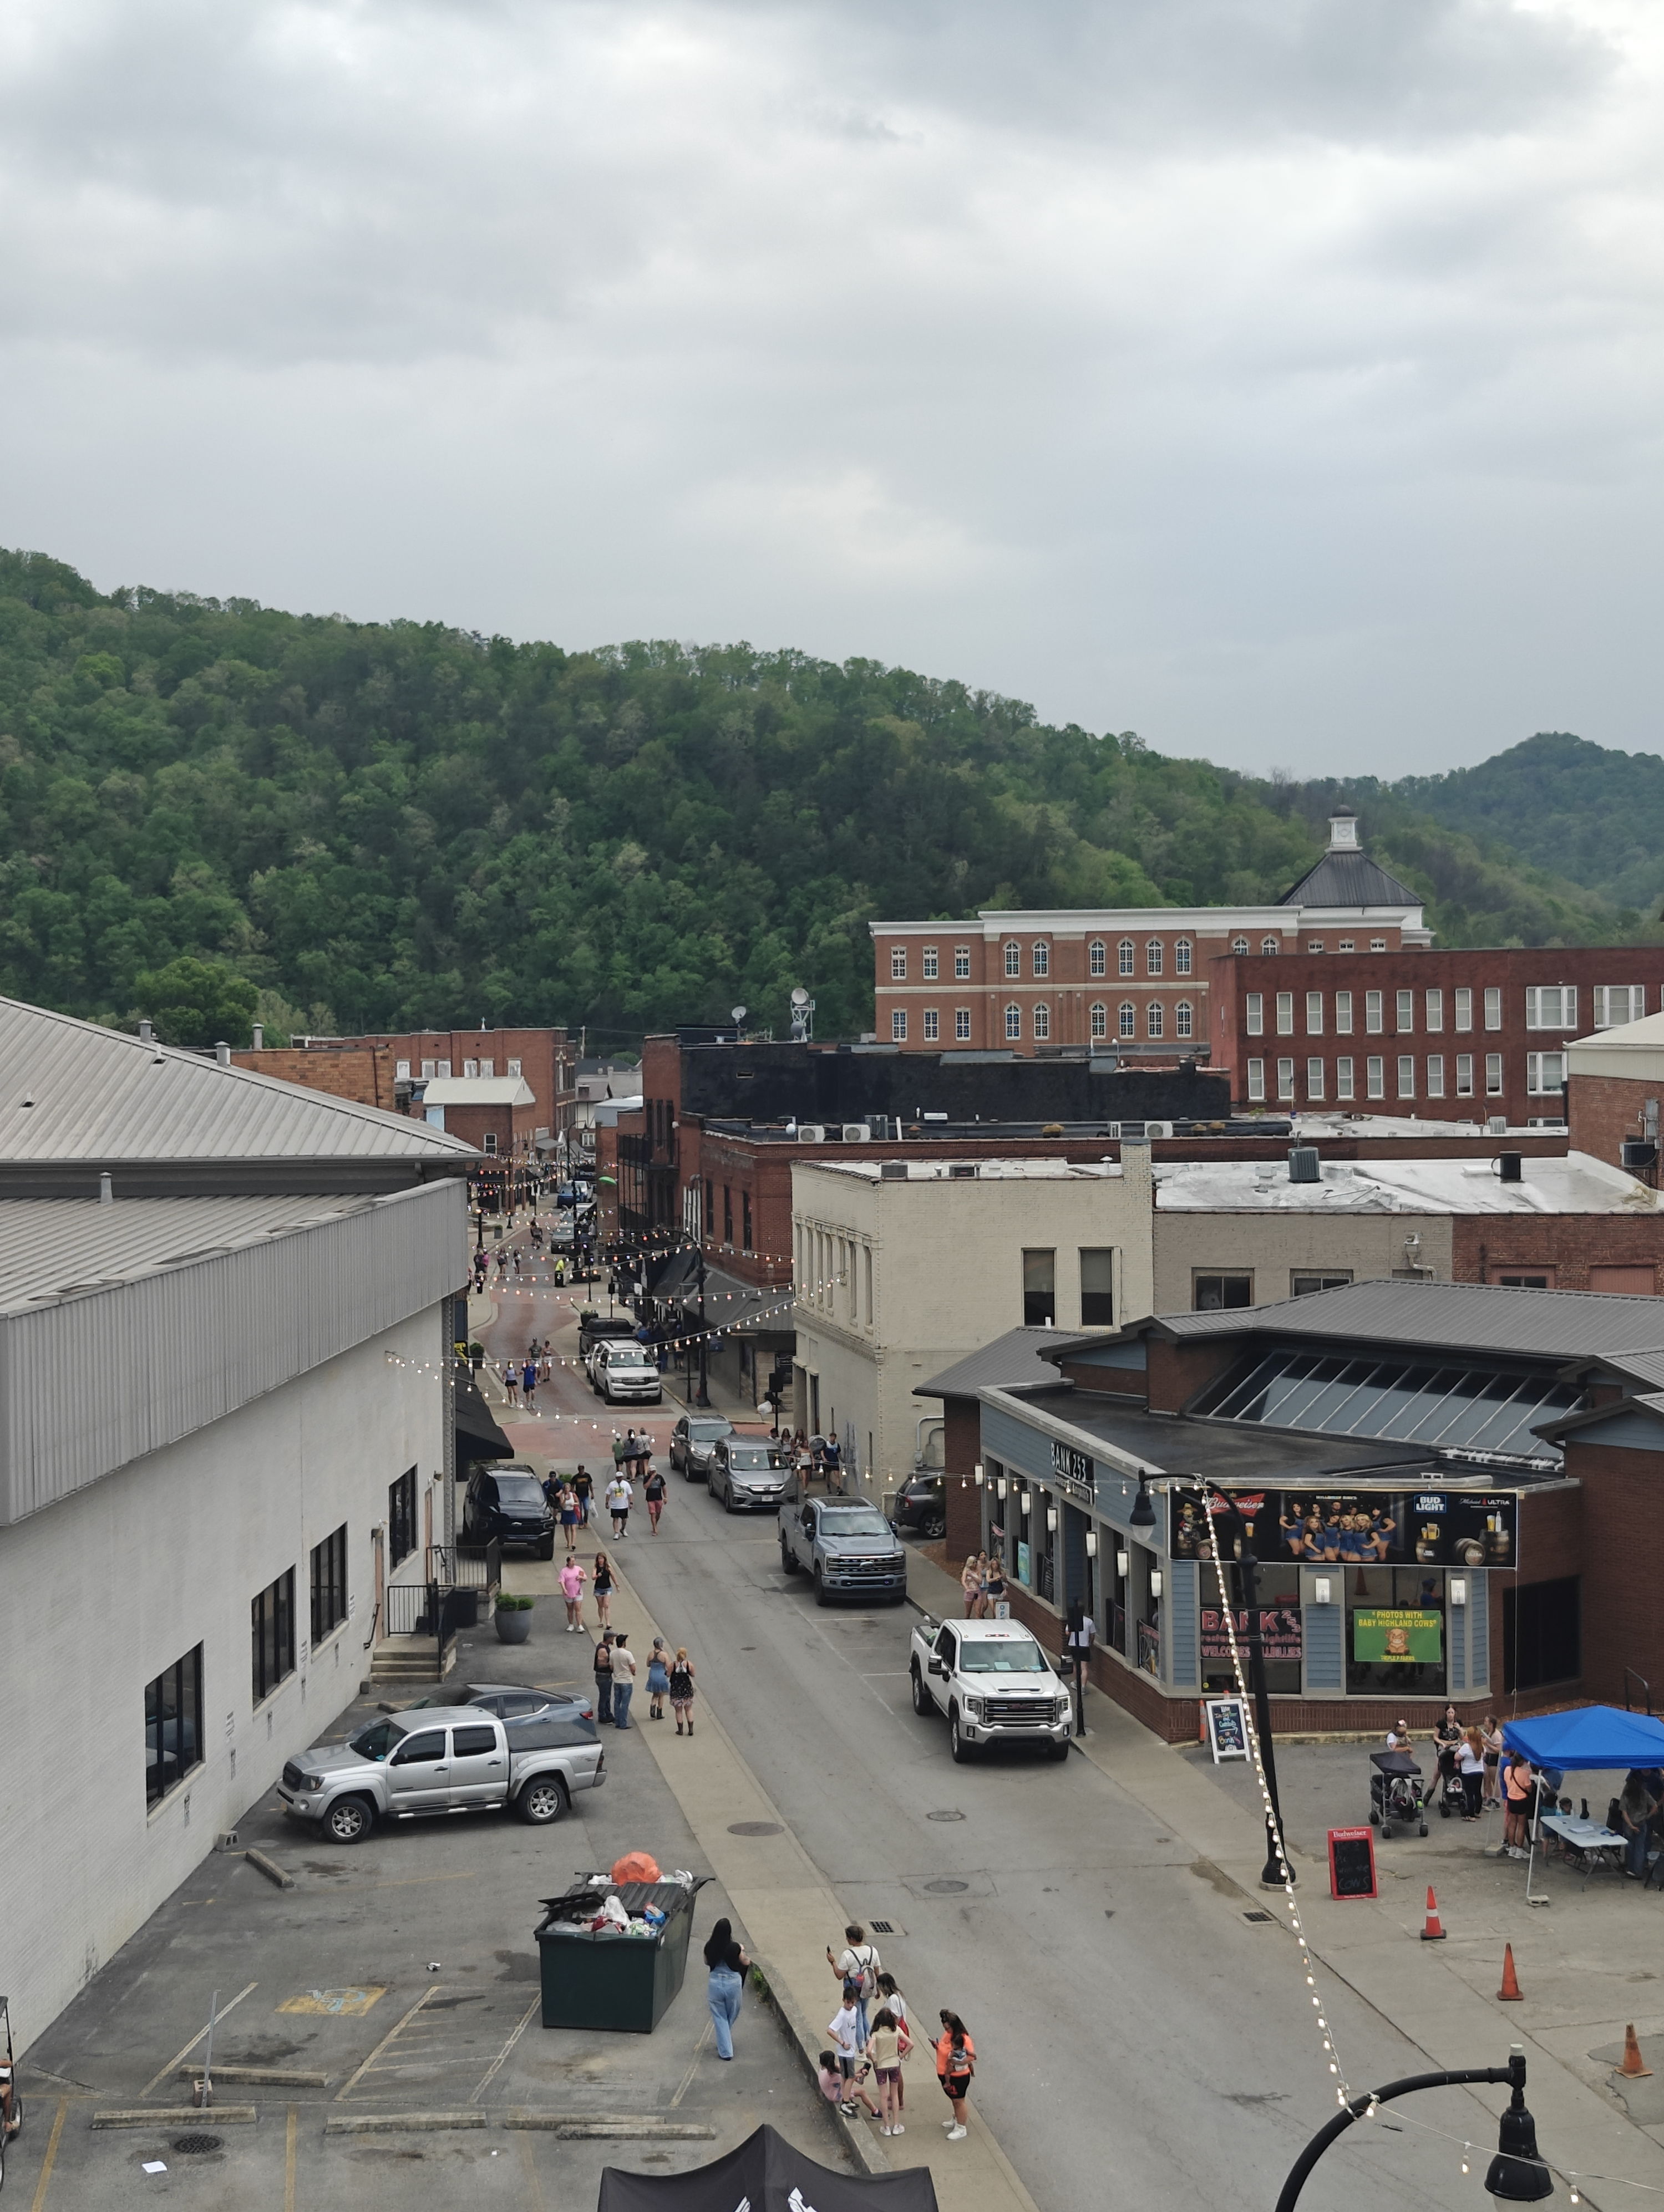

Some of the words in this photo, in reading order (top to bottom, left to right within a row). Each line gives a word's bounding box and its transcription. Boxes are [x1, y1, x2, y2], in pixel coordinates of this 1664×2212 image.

[1051, 1442, 1071, 1475] BANK
[1073, 1454, 1086, 1482] 253
[1281, 1610, 1302, 1633] 253
[1358, 1619, 1377, 1627] BABY
[1201, 1645, 1251, 1657] WELCOES
